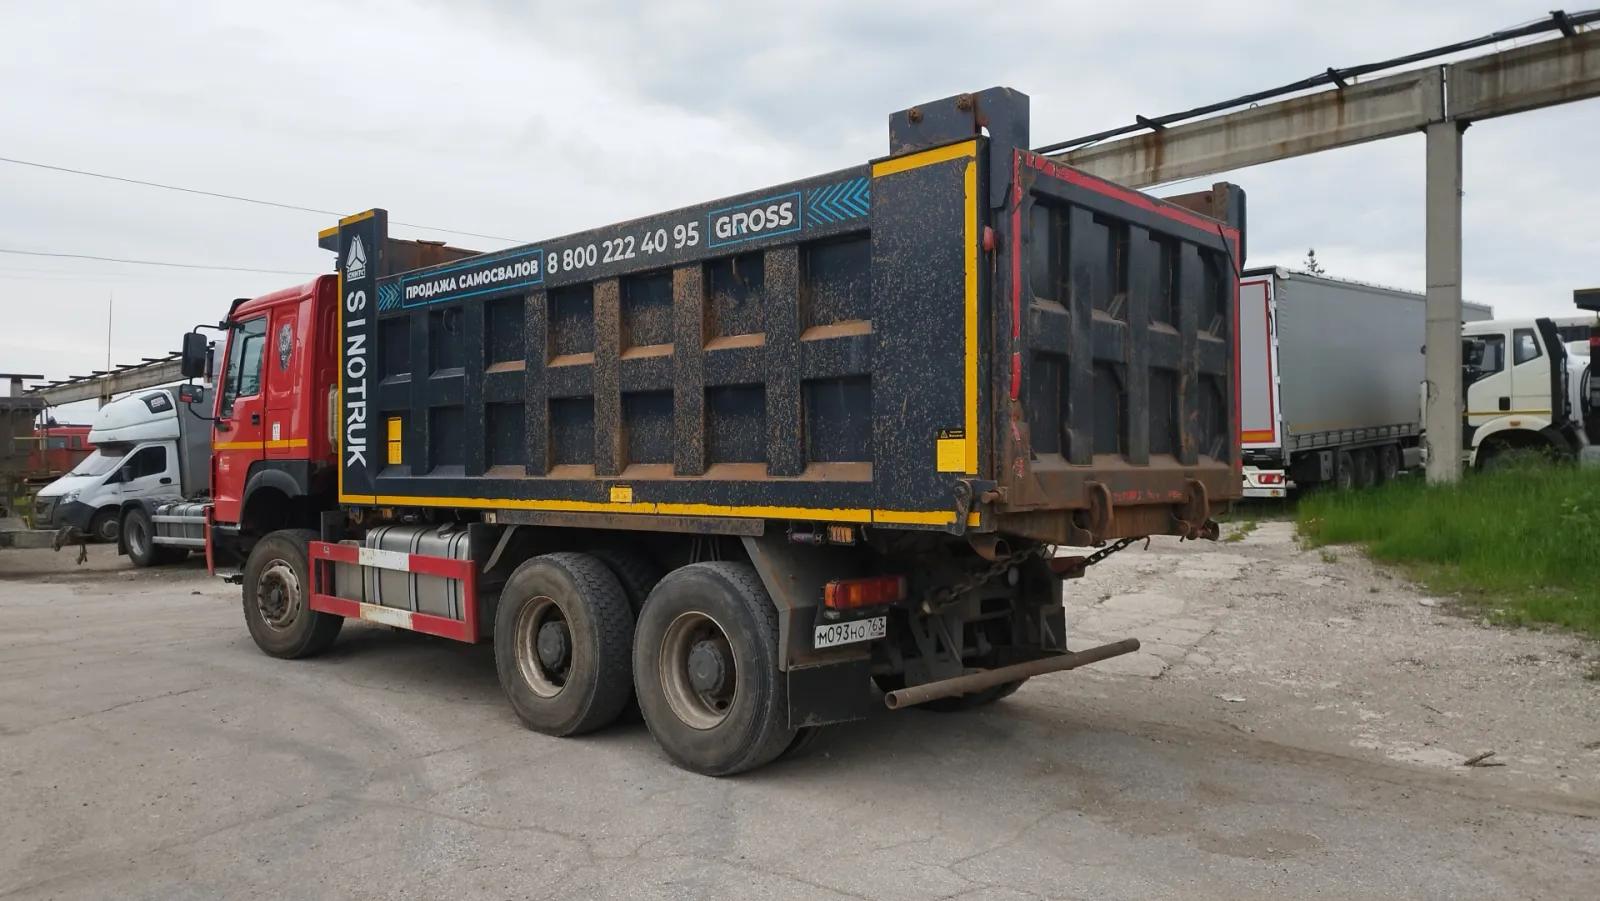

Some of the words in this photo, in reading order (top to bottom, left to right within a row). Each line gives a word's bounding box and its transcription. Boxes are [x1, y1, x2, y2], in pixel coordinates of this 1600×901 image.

[715, 202, 794, 239] GROSS
[547, 252, 558, 274] 8
[562, 247, 598, 271] 800
[602, 235, 636, 264] 222
[641, 228, 668, 255] 40
[673, 221, 699, 249] 95
[406, 279, 457, 299] ПРОДАЖА
[459, 259, 539, 289] САМОСВАЛОВ
[346, 290, 367, 468] SINOTRUK
